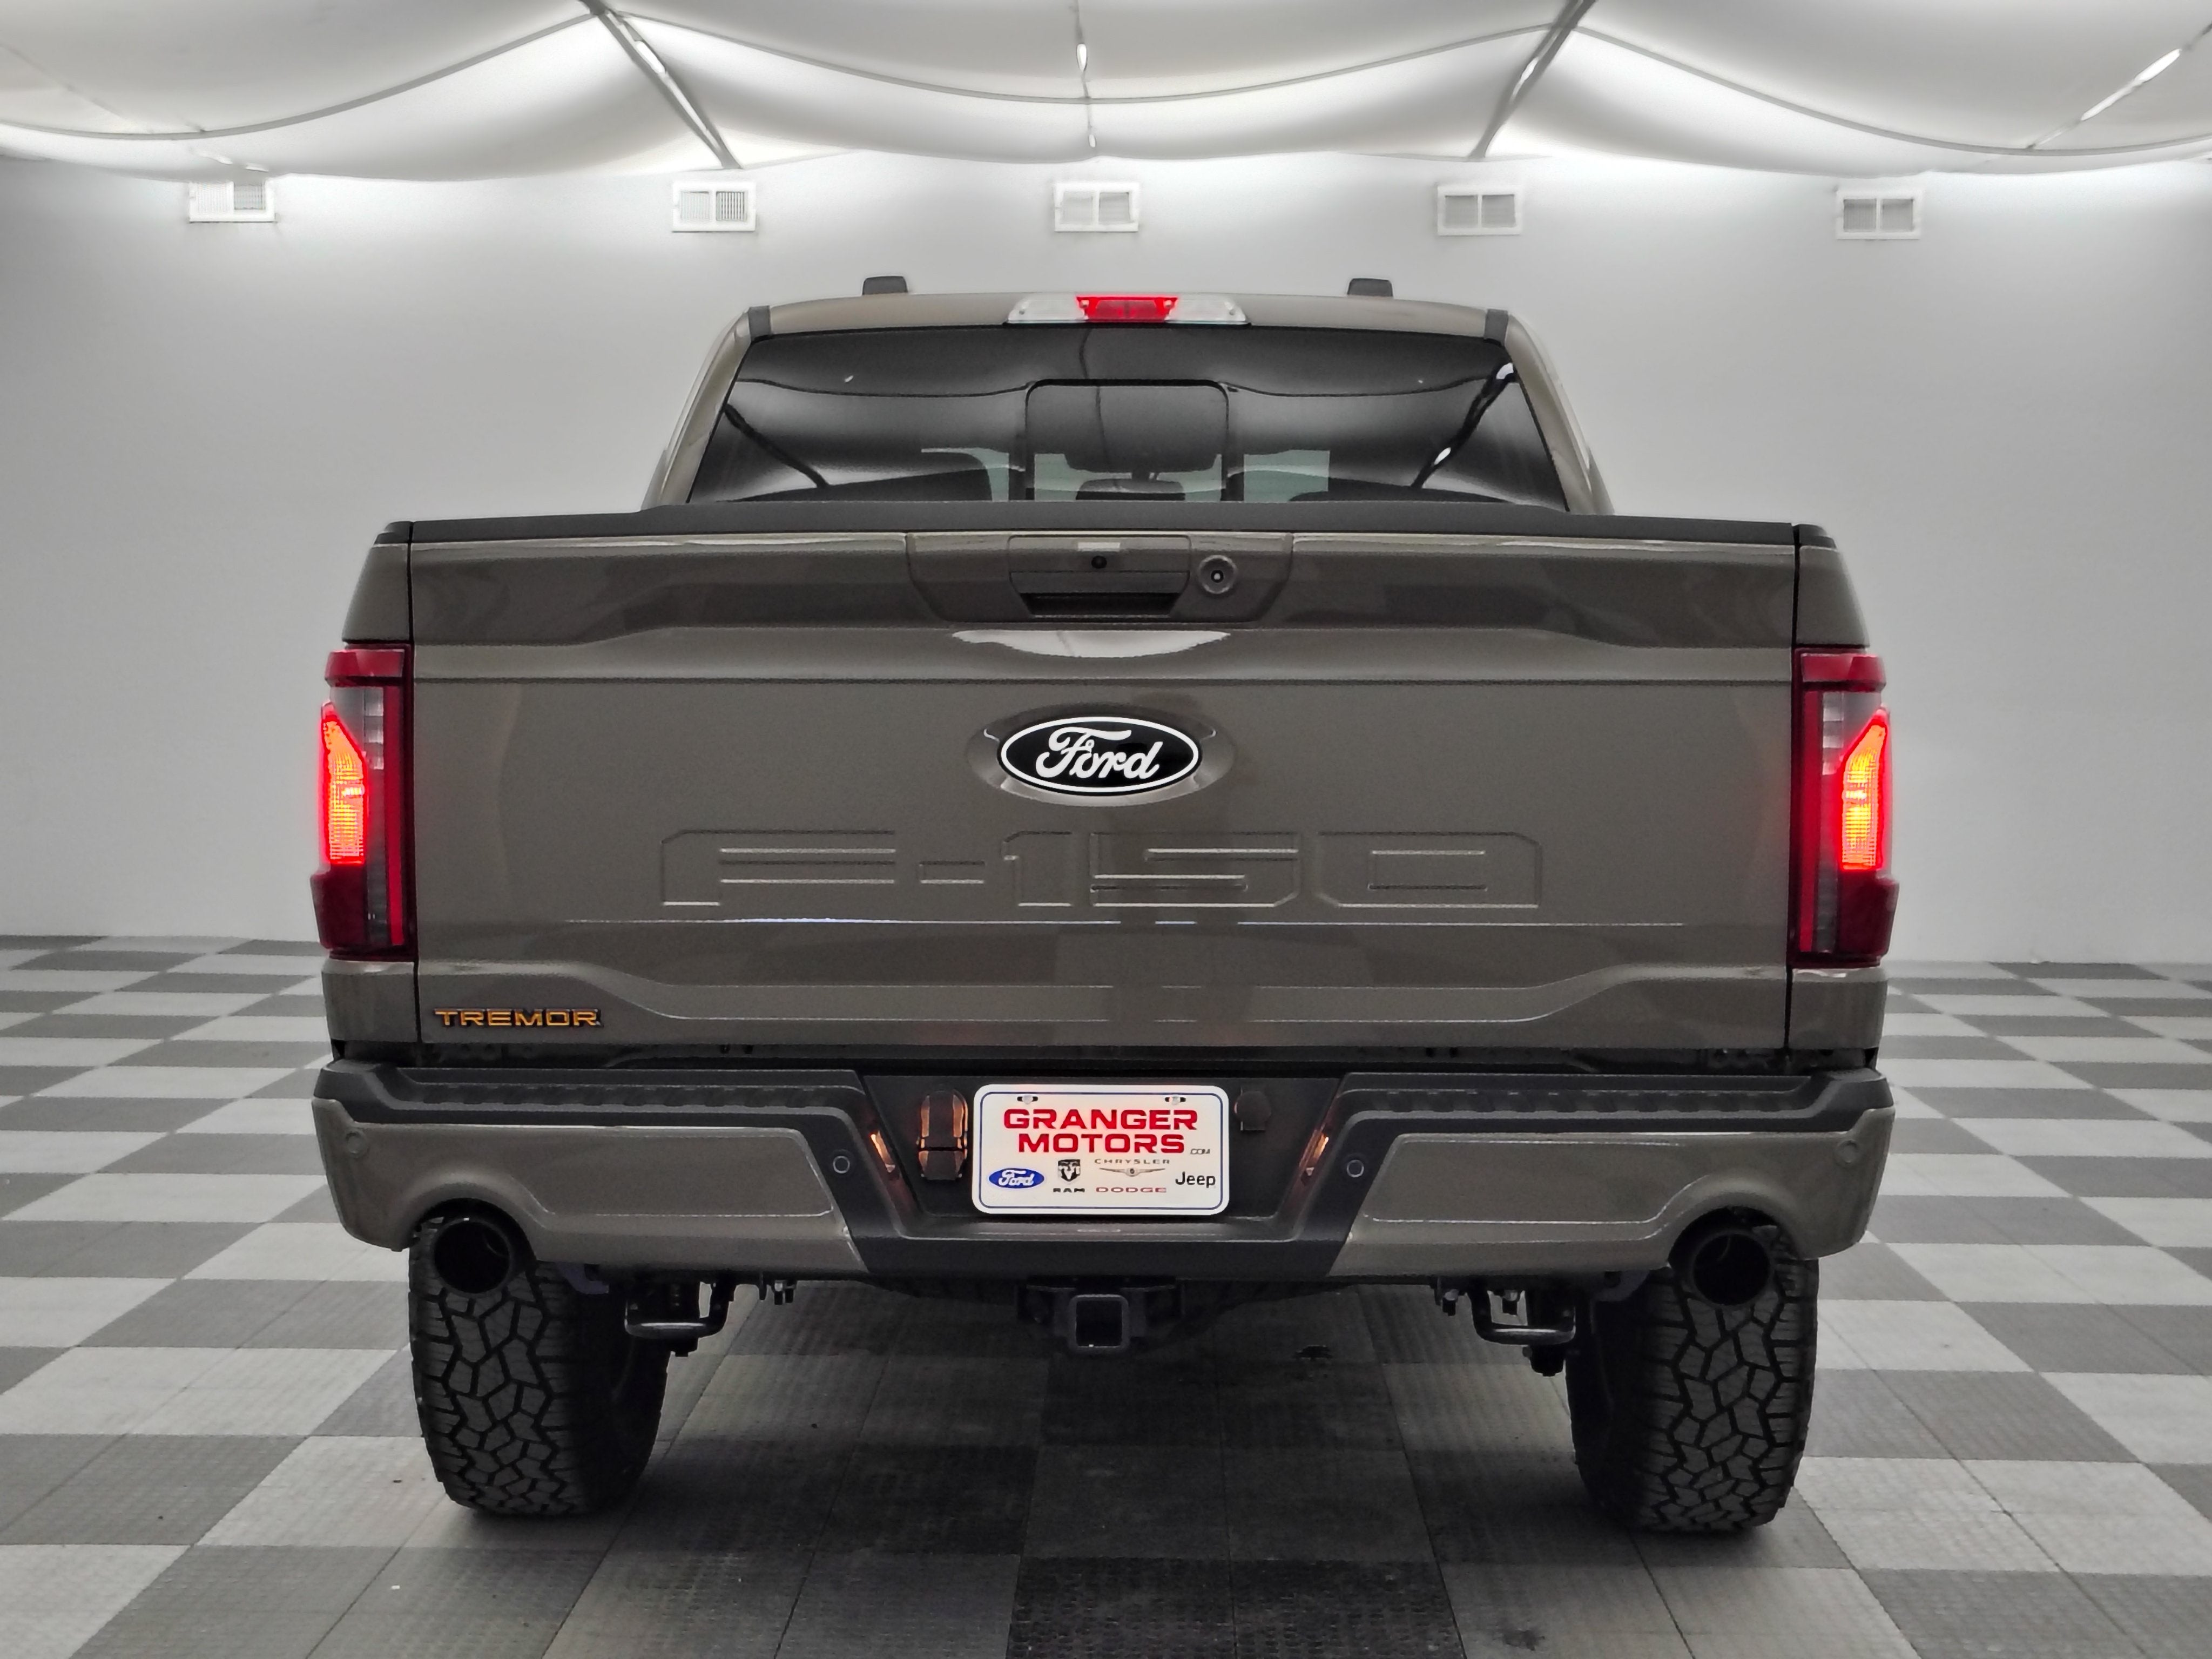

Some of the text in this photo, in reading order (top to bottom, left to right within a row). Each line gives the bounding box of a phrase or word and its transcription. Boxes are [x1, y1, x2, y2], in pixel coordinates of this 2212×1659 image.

[1035, 726, 1164, 779] Ford
[661, 830, 1543, 908] F-150
[434, 1008, 604, 1026] TREMOR
[1003, 1109, 1198, 1130] GRANGER
[1019, 1133, 1185, 1154] MOTORS
[997, 1169, 1035, 1186] Ford
[1175, 1171, 1216, 1189] Jeep
